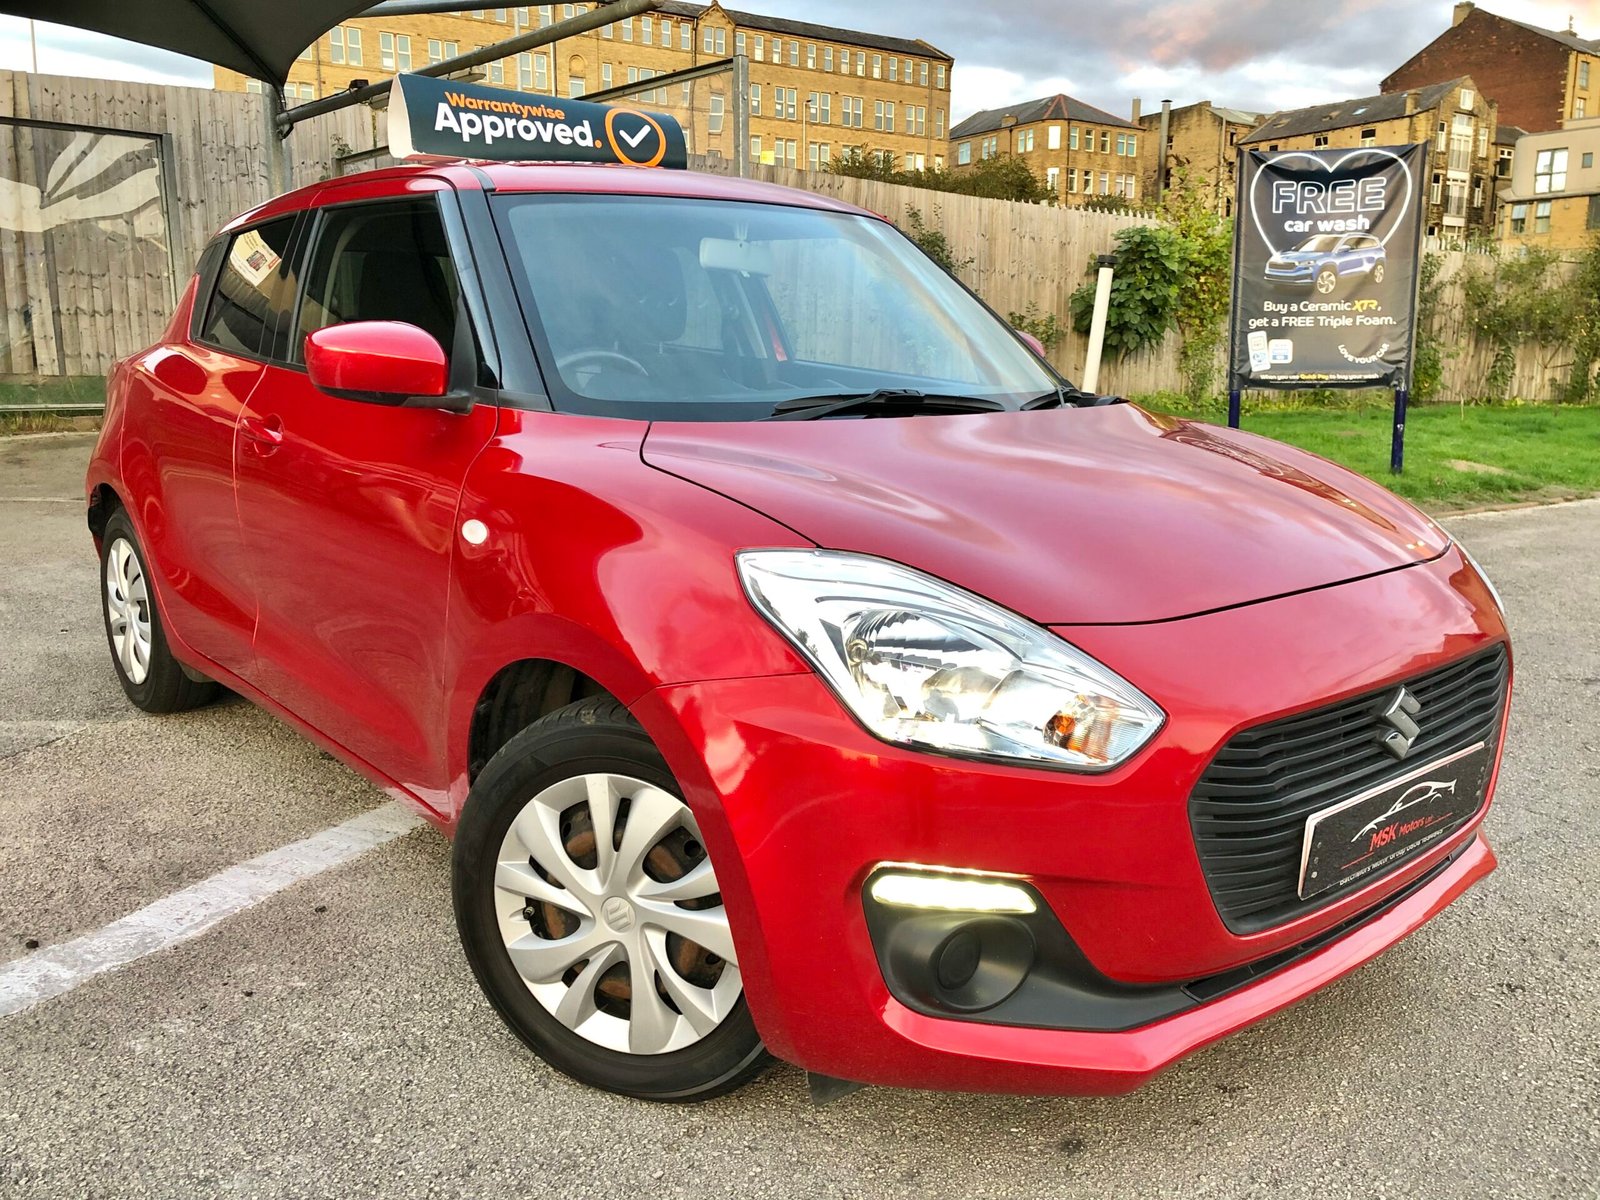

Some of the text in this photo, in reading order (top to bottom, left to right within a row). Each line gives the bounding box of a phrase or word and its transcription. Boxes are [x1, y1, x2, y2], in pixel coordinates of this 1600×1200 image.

[445, 91, 565, 120] Warrantywise
[434, 102, 602, 149] Approved.
[1272, 177, 1387, 214] FREE
[1284, 214, 1370, 232] car wash
[1263, 301, 1289, 314] Buy
[1290, 303, 1298, 312] a
[1300, 300, 1351, 312] Ceramic
[1249, 315, 1397, 329] get a FREE Triple Foam.
[1338, 344, 1354, 362] LOVE
[1355, 355, 1378, 365] YOUR
[1370, 821, 1399, 851] MSK
[1399, 816, 1425, 837] Motors
